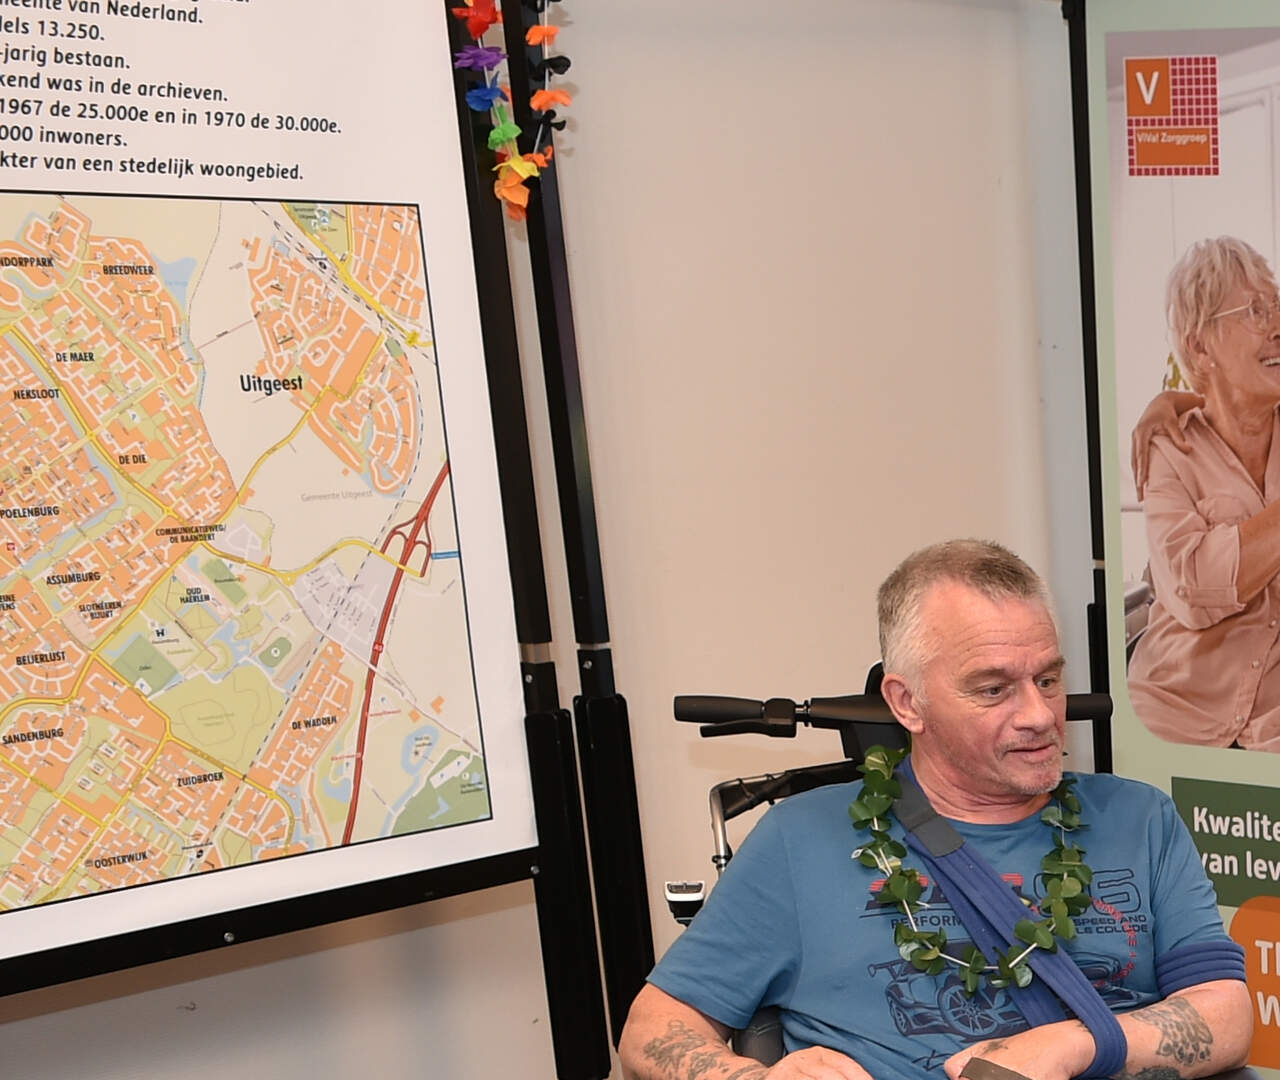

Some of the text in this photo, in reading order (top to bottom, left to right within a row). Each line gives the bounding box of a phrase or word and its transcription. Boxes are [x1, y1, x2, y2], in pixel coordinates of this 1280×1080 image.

[69, 1, 100, 14] van
[107, 1, 203, 23] Nederland.
[38, 20, 105, 41] 13.250.
[53, 47, 130, 69] bestaan.
[47, 77, 83, 92] was
[89, 76, 104, 94] in
[111, 78, 132, 95] de
[137, 81, 228, 102] archieven.
[1135, 71, 1160, 105] V
[50, 100, 71, 118] de
[77, 103, 149, 122] 25.000e
[155, 111, 176, 124] en
[182, 108, 198, 125] in
[204, 111, 246, 128] 1970
[251, 113, 270, 129] de
[274, 115, 342, 134] 30.000e.
[39, 126, 128, 147] inwoners.
[0, 152, 304, 182] kter van een stedelijk woongebied.
[103, 264, 155, 276] BREEDWEER
[56, 352, 95, 363] DE MAER
[13, 388, 60, 400] NEKSLOOT
[240, 374, 304, 396] Uitgeest
[119, 454, 147, 465] DE DIE
[46, 572, 101, 585] ASSUMBURG
[291, 715, 337, 730] DE WADDEN
[2, 728, 64, 744] SANDENBURG
[177, 772, 224, 787] ZUIDBROEK
[95, 851, 148, 868] OOSTERWIJK
